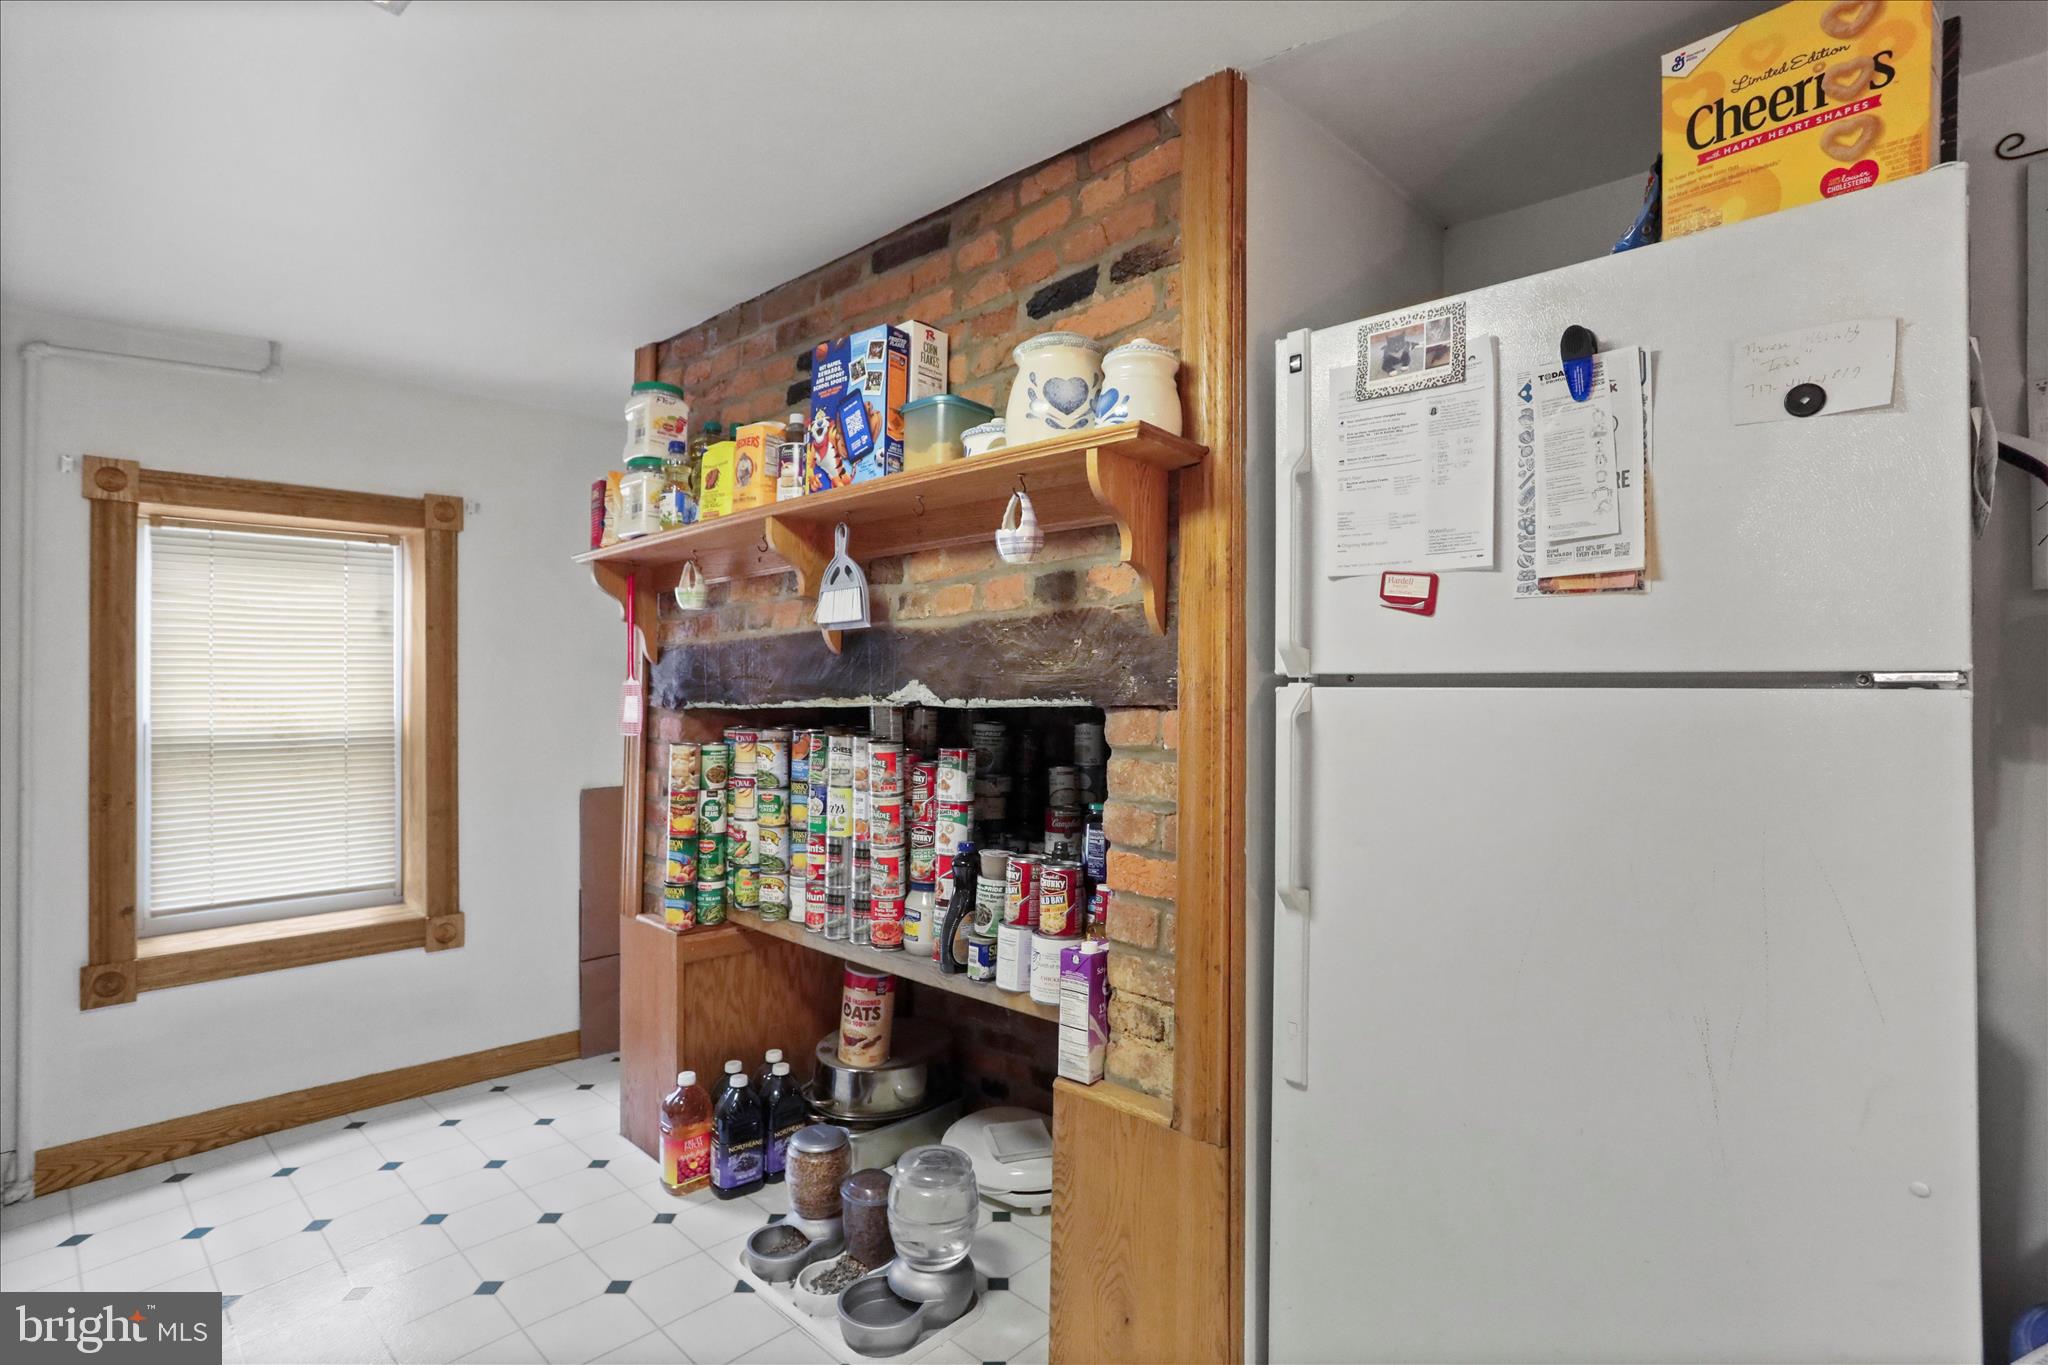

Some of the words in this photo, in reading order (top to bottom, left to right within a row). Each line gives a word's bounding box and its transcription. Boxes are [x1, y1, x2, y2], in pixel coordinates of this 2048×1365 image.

[1731, 61, 1789, 94] Limited
[1790, 44, 1850, 70] Edition
[1723, 135, 1763, 155] HAPPY
[1768, 120, 1809, 140] HEART
[1815, 100, 1870, 125] SHAPES
[1827, 175, 1872, 194] CHOLESTEROL
[1841, 171, 1870, 183] lower
[922, 341, 938, 356] CORN
[920, 351, 940, 369] FLAKES
[1538, 371, 1565, 382] TODA
[1041, 878, 1066, 889] CHUNKY
[1050, 895, 1064, 905] BAY
[843, 1002, 881, 1021] OATS
[774, 1124, 804, 1139] NORTHLAN
